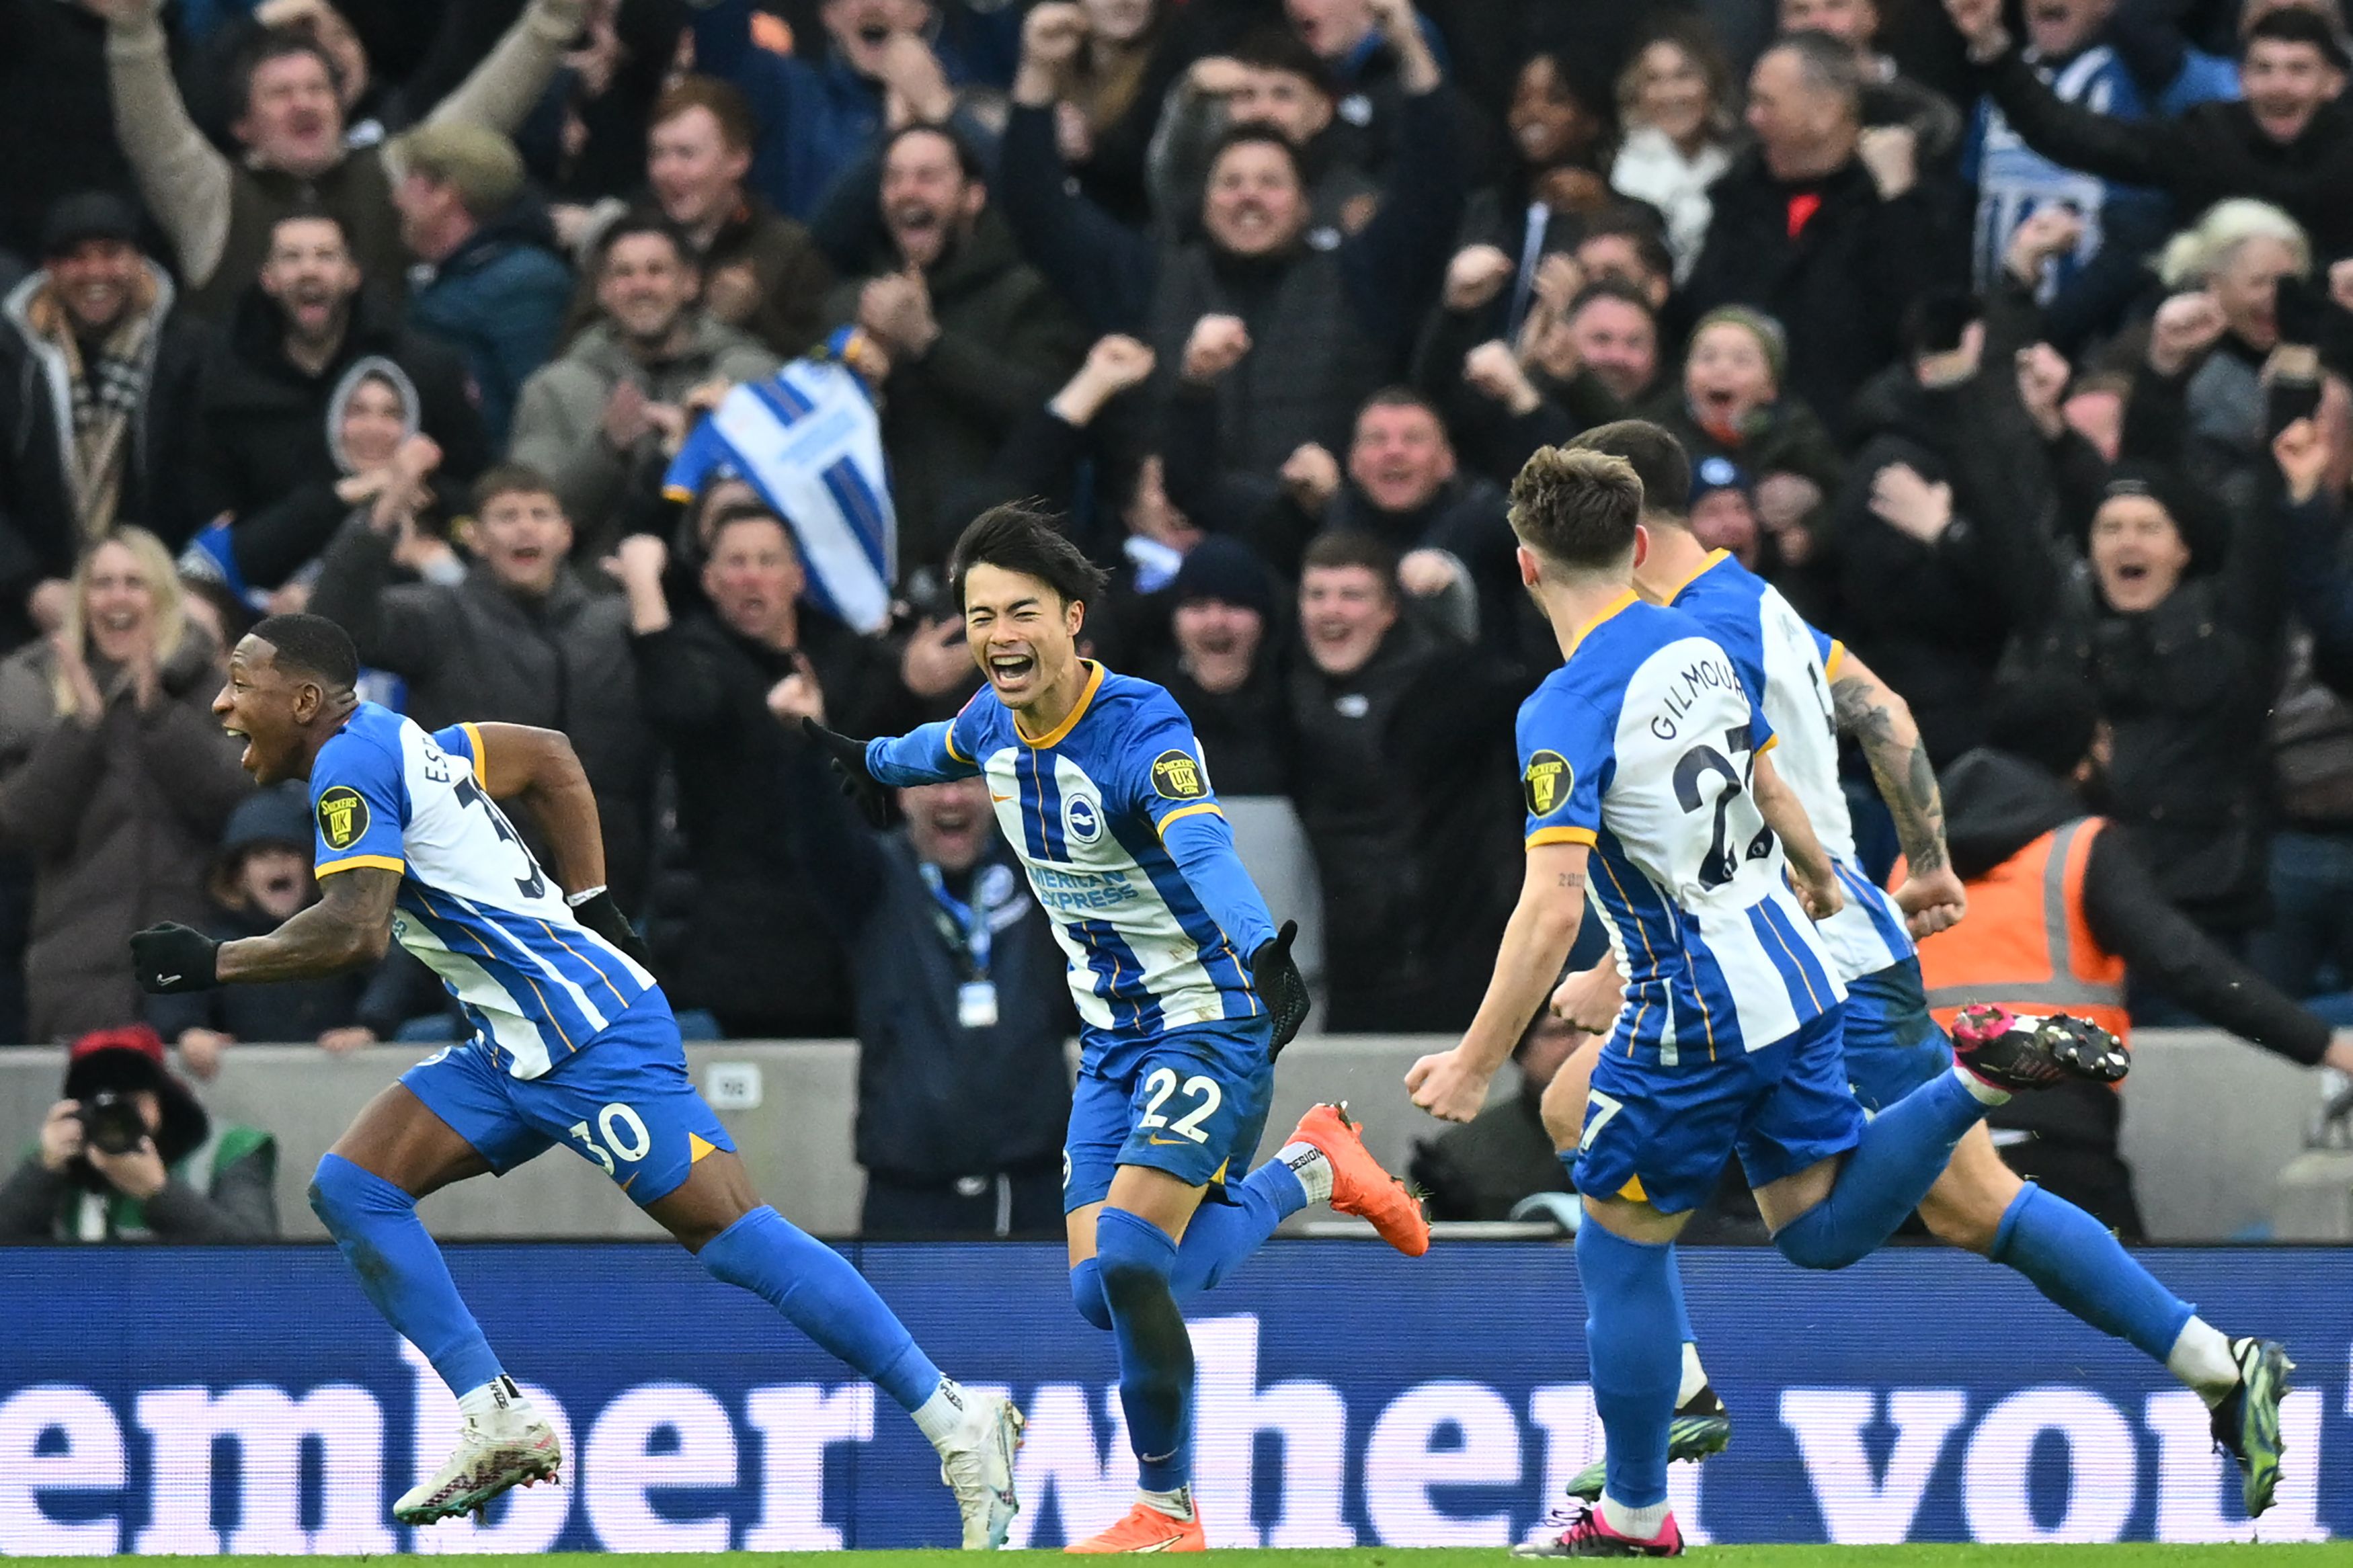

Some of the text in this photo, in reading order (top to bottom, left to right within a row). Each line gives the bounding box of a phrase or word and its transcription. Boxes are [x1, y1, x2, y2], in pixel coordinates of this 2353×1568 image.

[1172, 770, 1194, 785] UK
[332, 811, 347, 833] UK
[1028, 866, 1127, 889] MERICAN
[1041, 883, 1139, 911] EXPRESS
[1138, 1067, 1222, 1144] 22
[1579, 1088, 1624, 1151] 7
[569, 1102, 650, 1175] 30
